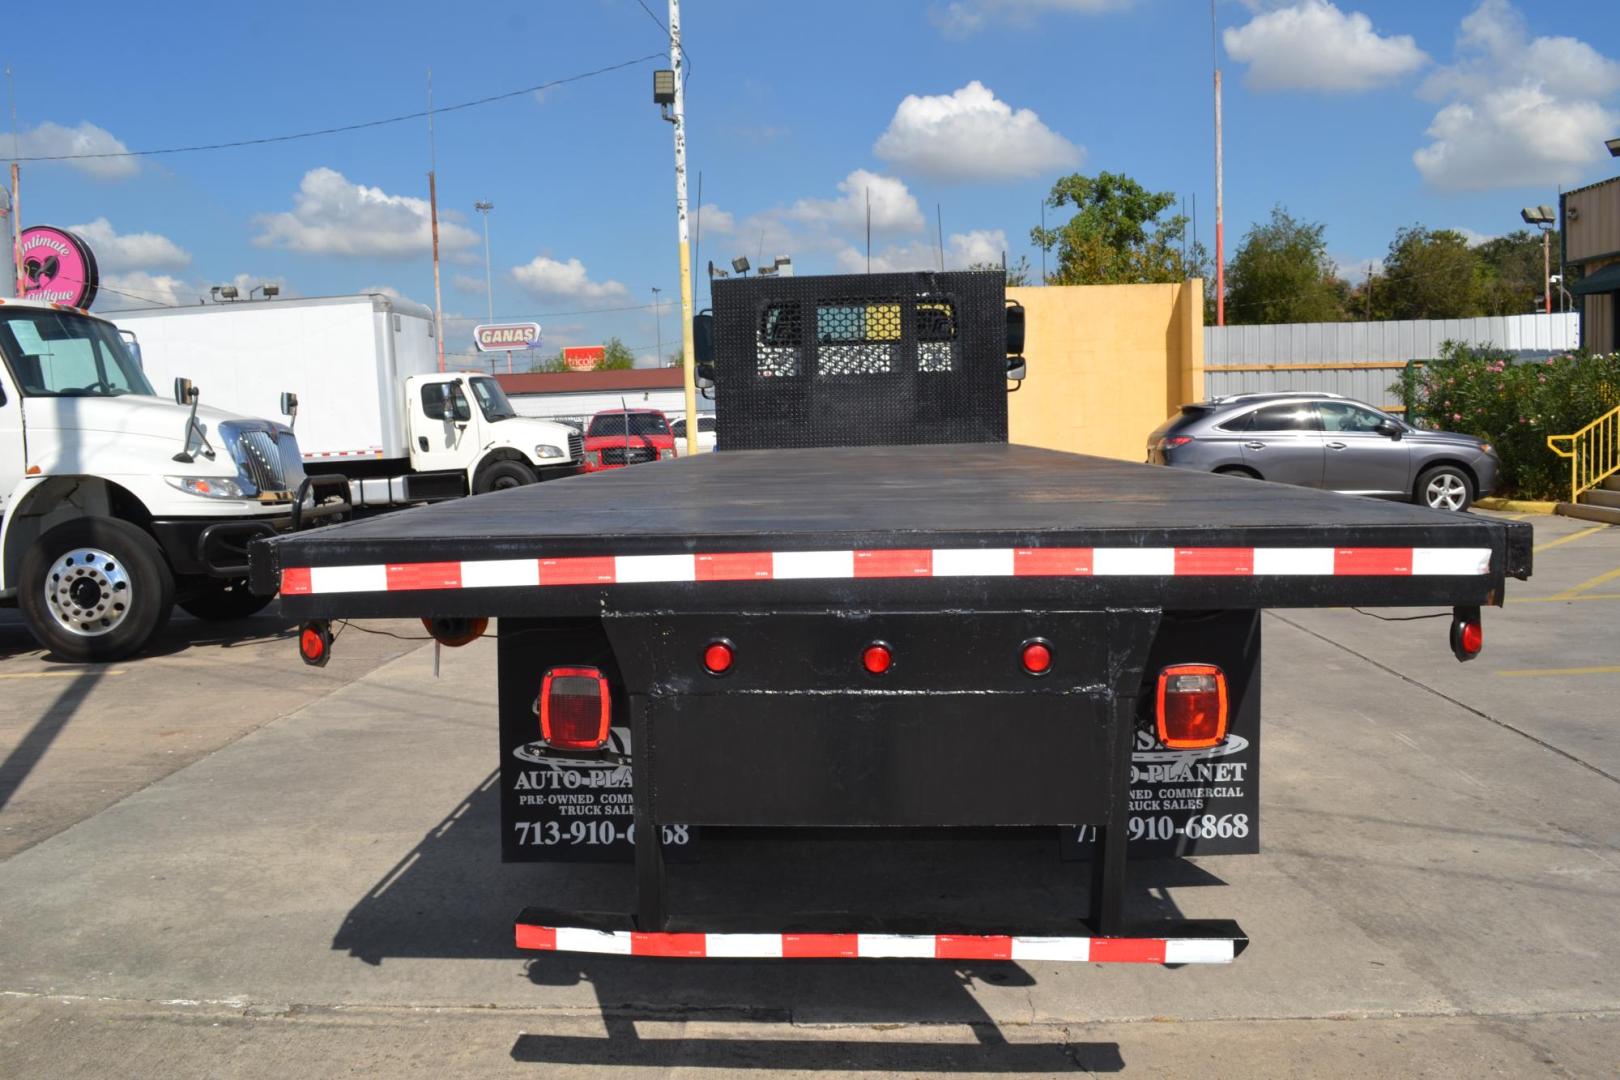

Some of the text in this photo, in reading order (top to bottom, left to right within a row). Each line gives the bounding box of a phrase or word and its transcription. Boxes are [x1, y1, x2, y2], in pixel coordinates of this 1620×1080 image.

[22, 235, 70, 257] ntimate
[27, 288, 74, 303] outique
[481, 328, 534, 343] GANAS
[519, 794, 594, 805] PRE-OWNED
[1159, 787, 1244, 799] COMMERCIAL
[559, 805, 602, 816] TRUCK
[1163, 800, 1203, 810] SALES
[514, 820, 689, 845] 713-910-668
